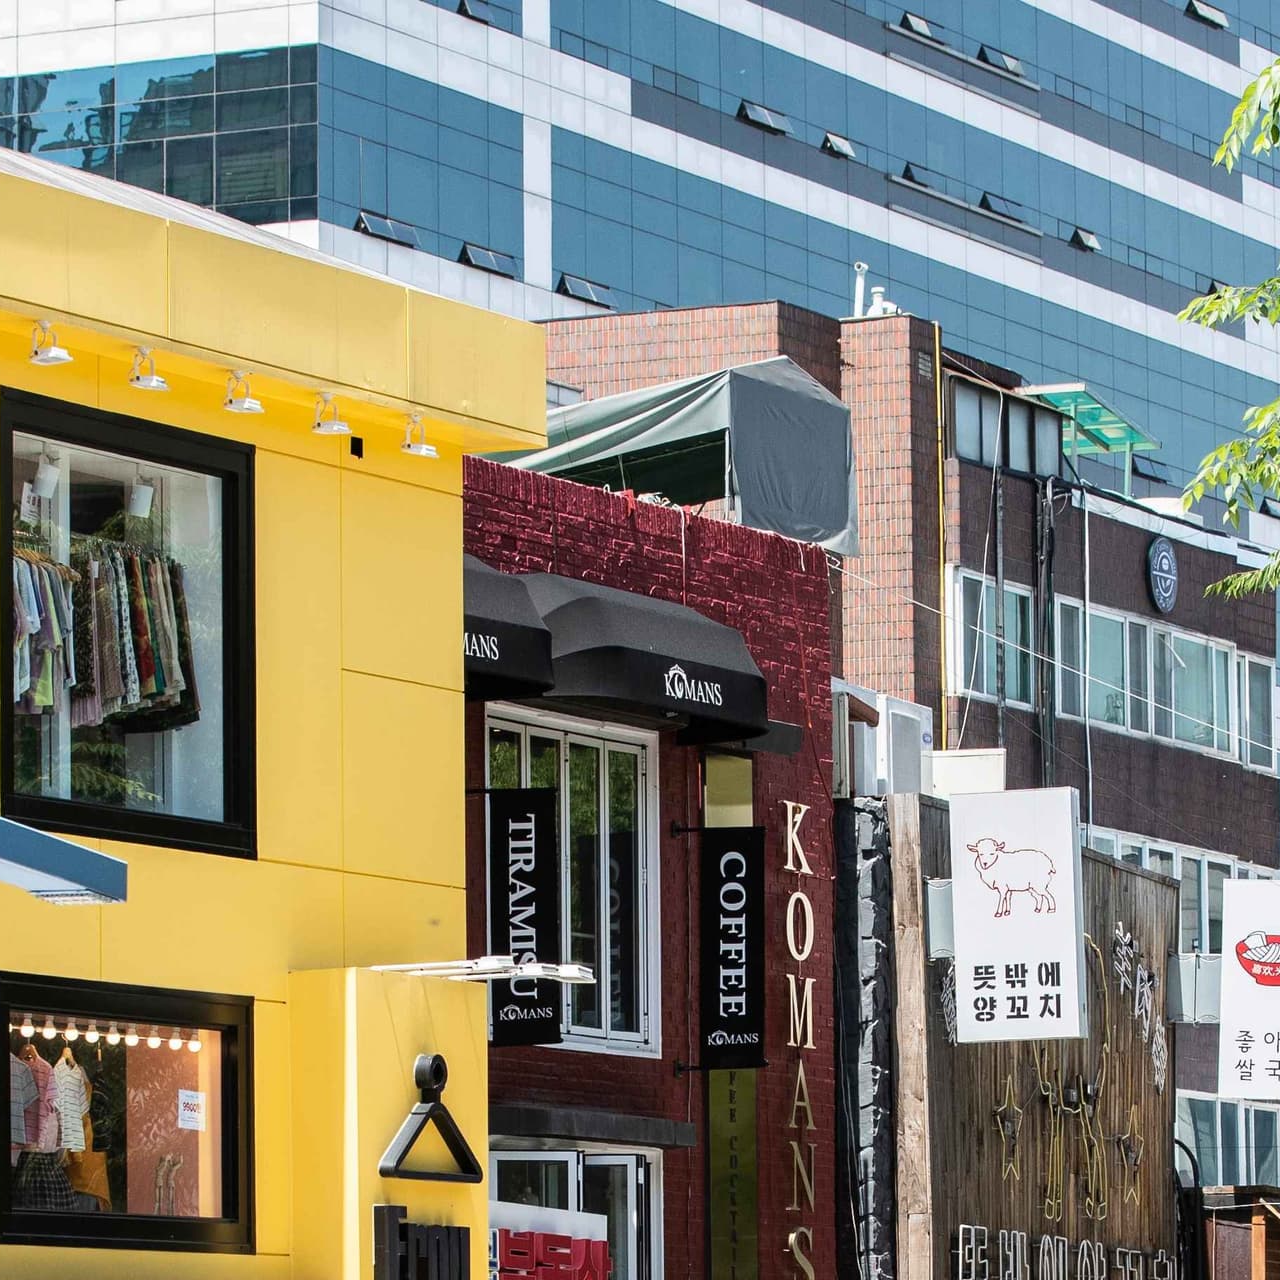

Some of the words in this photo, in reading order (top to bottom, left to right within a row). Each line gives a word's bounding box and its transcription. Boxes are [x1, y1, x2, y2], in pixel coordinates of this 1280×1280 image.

[664, 670, 722, 707] KOMANS
[719, 850, 747, 1018] COFFEE
[972, 961, 1062, 991] 뜻밖에
[499, 1004, 553, 1022] KOMANS
[972, 993, 1062, 1022] 양꼬치
[707, 1029, 759, 1046] KOMANS
